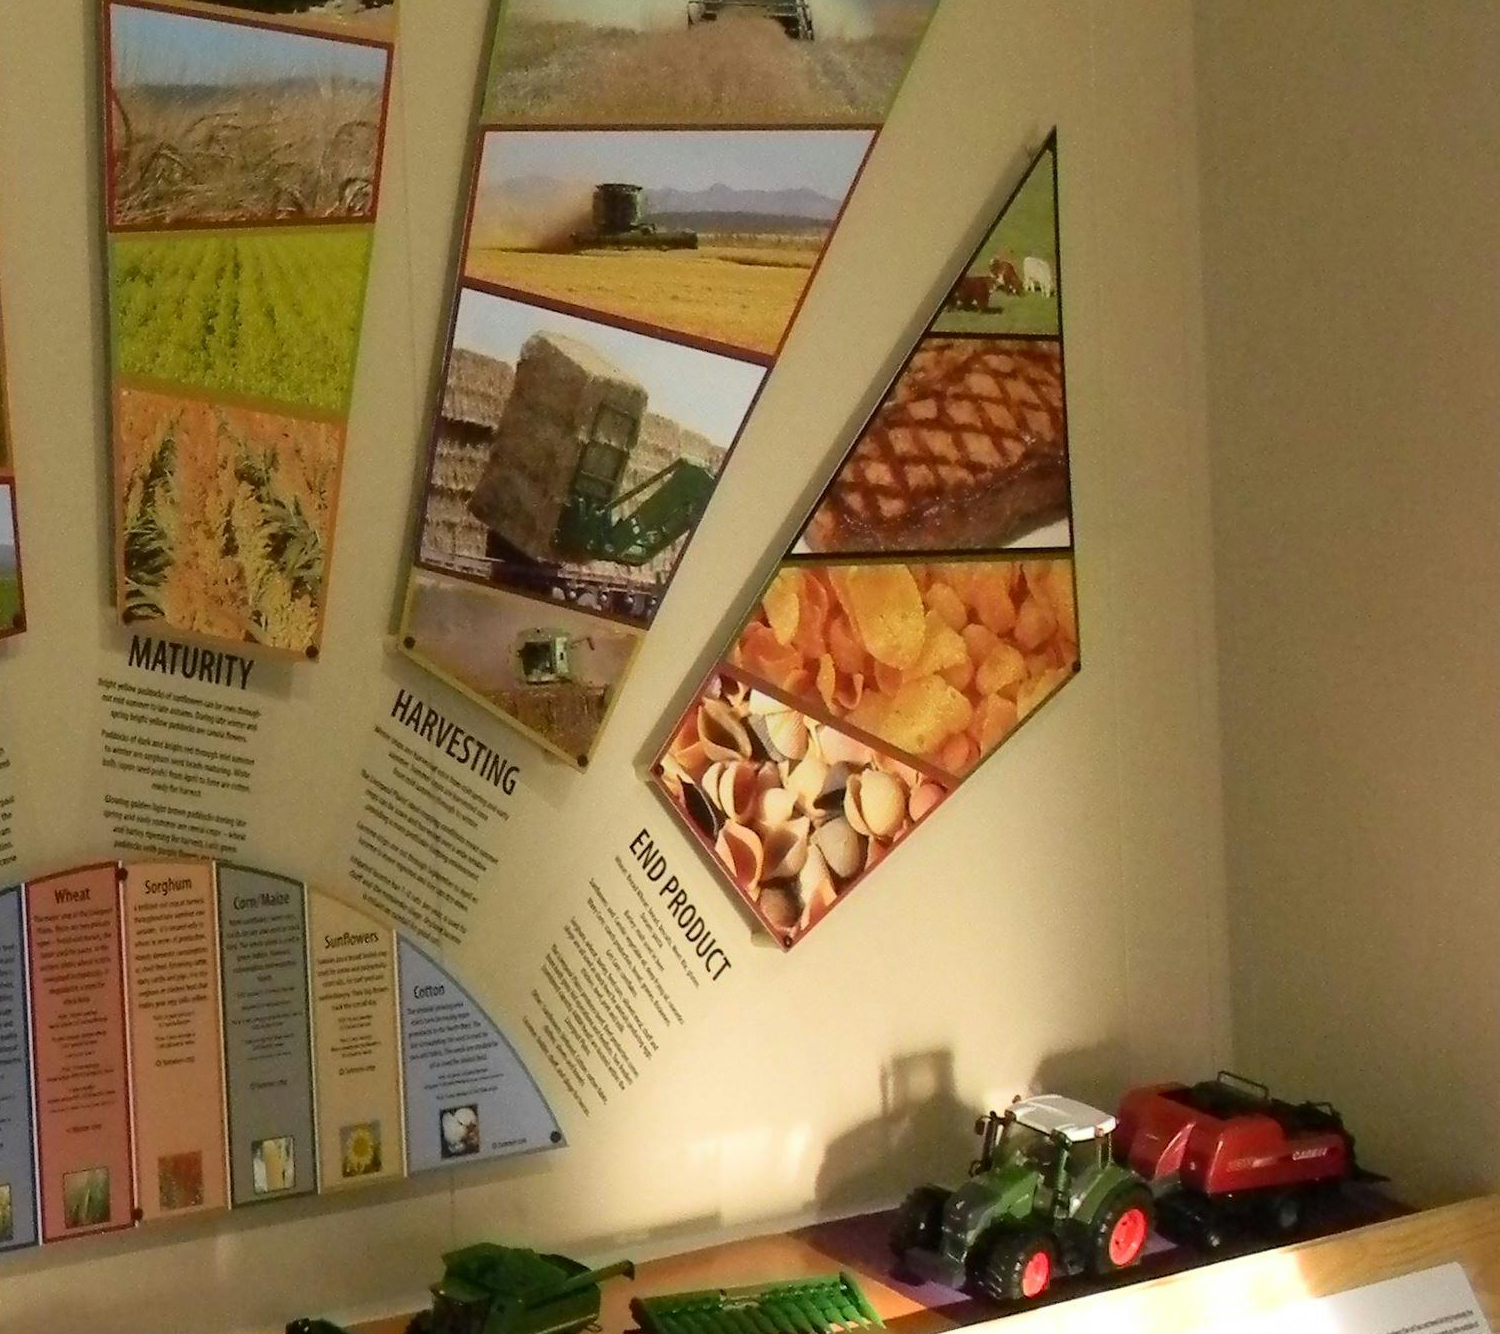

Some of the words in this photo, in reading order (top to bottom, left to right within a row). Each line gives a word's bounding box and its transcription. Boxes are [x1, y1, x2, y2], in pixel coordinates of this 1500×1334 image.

[128, 635, 255, 690] MATURITY
[391, 689, 520, 795] HARVESTING
[145, 877, 192, 896] Sorghum
[54, 887, 92, 905] Wheat
[233, 892, 290, 910] Corn/Maize
[630, 828, 667, 883] END
[659, 876, 732, 982] PRODUCT
[324, 931, 379, 949] Sunflowers
[413, 983, 445, 1001] Cotton
